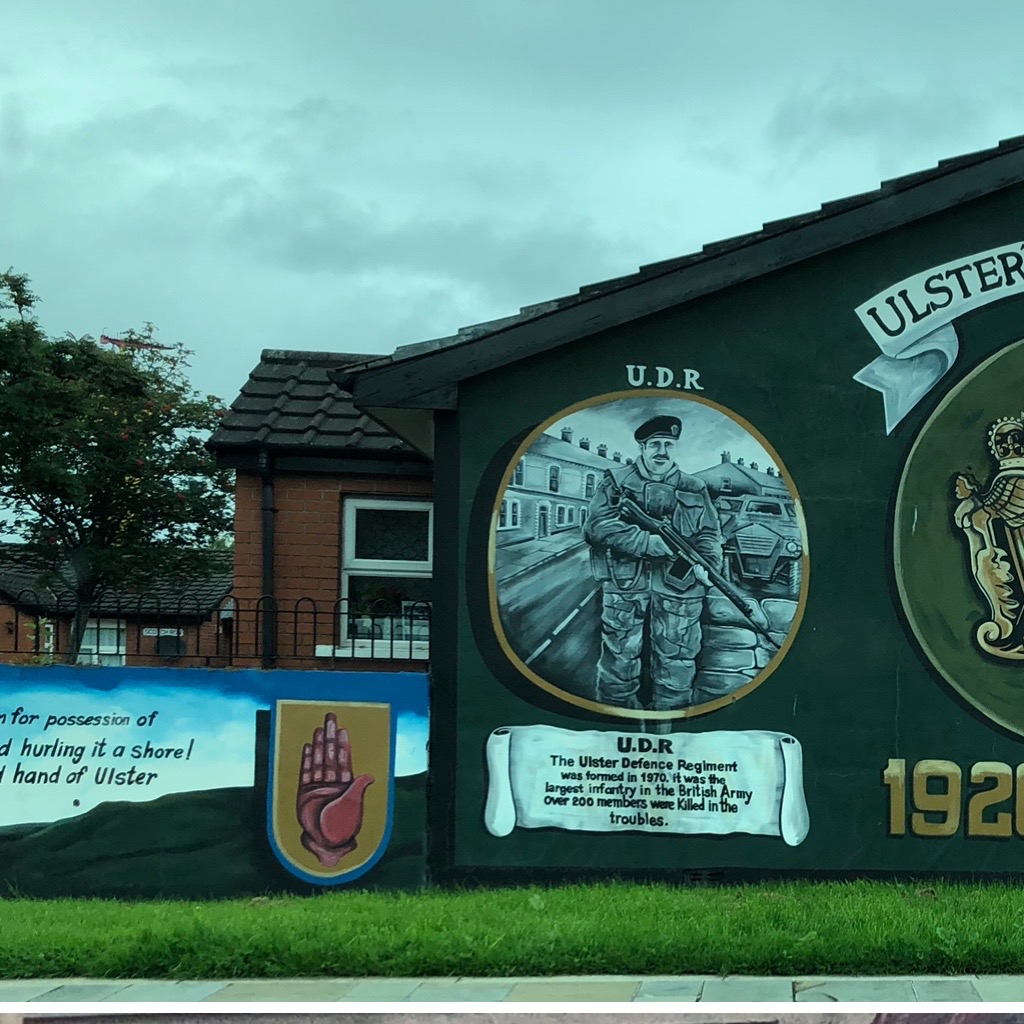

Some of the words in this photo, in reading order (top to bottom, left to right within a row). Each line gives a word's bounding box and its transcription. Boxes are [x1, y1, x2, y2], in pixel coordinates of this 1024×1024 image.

[11, 706, 40, 725] for
[43, 713, 130, 731] possession
[136, 710, 159, 727] of
[20, 737, 86, 765] hurling
[91, 738, 107, 758] it
[112, 745, 126, 758] a
[12, 762, 62, 785] hand
[65, 765, 88, 785] of
[94, 765, 158, 786] Ulster
[550, 754, 575, 767] The
[579, 755, 620, 769] Ulster
[621, 757, 674, 770] Defence
[677, 759, 738, 775] Regiment
[561, 771, 583, 781] was
[585, 770, 625, 782] formed
[627, 772, 637, 783] in
[672, 773, 682, 783] it
[683, 775, 706, 785] was
[708, 774, 727, 785] the
[543, 795, 570, 806] Over
[571, 796, 594, 807] 200
[597, 795, 648, 809] members
[649, 799, 675, 811] were
[677, 797, 705, 811] Killed
[708, 799, 719, 812] in
[719, 797, 738, 813] the
[544, 782, 584, 796] largest
[588, 782, 637, 799] infantry
[639, 784, 651, 796] in
[655, 783, 675, 797] the
[678, 784, 717, 798] British
[720, 784, 753, 806] Army
[609, 811, 669, 827] troubles.
